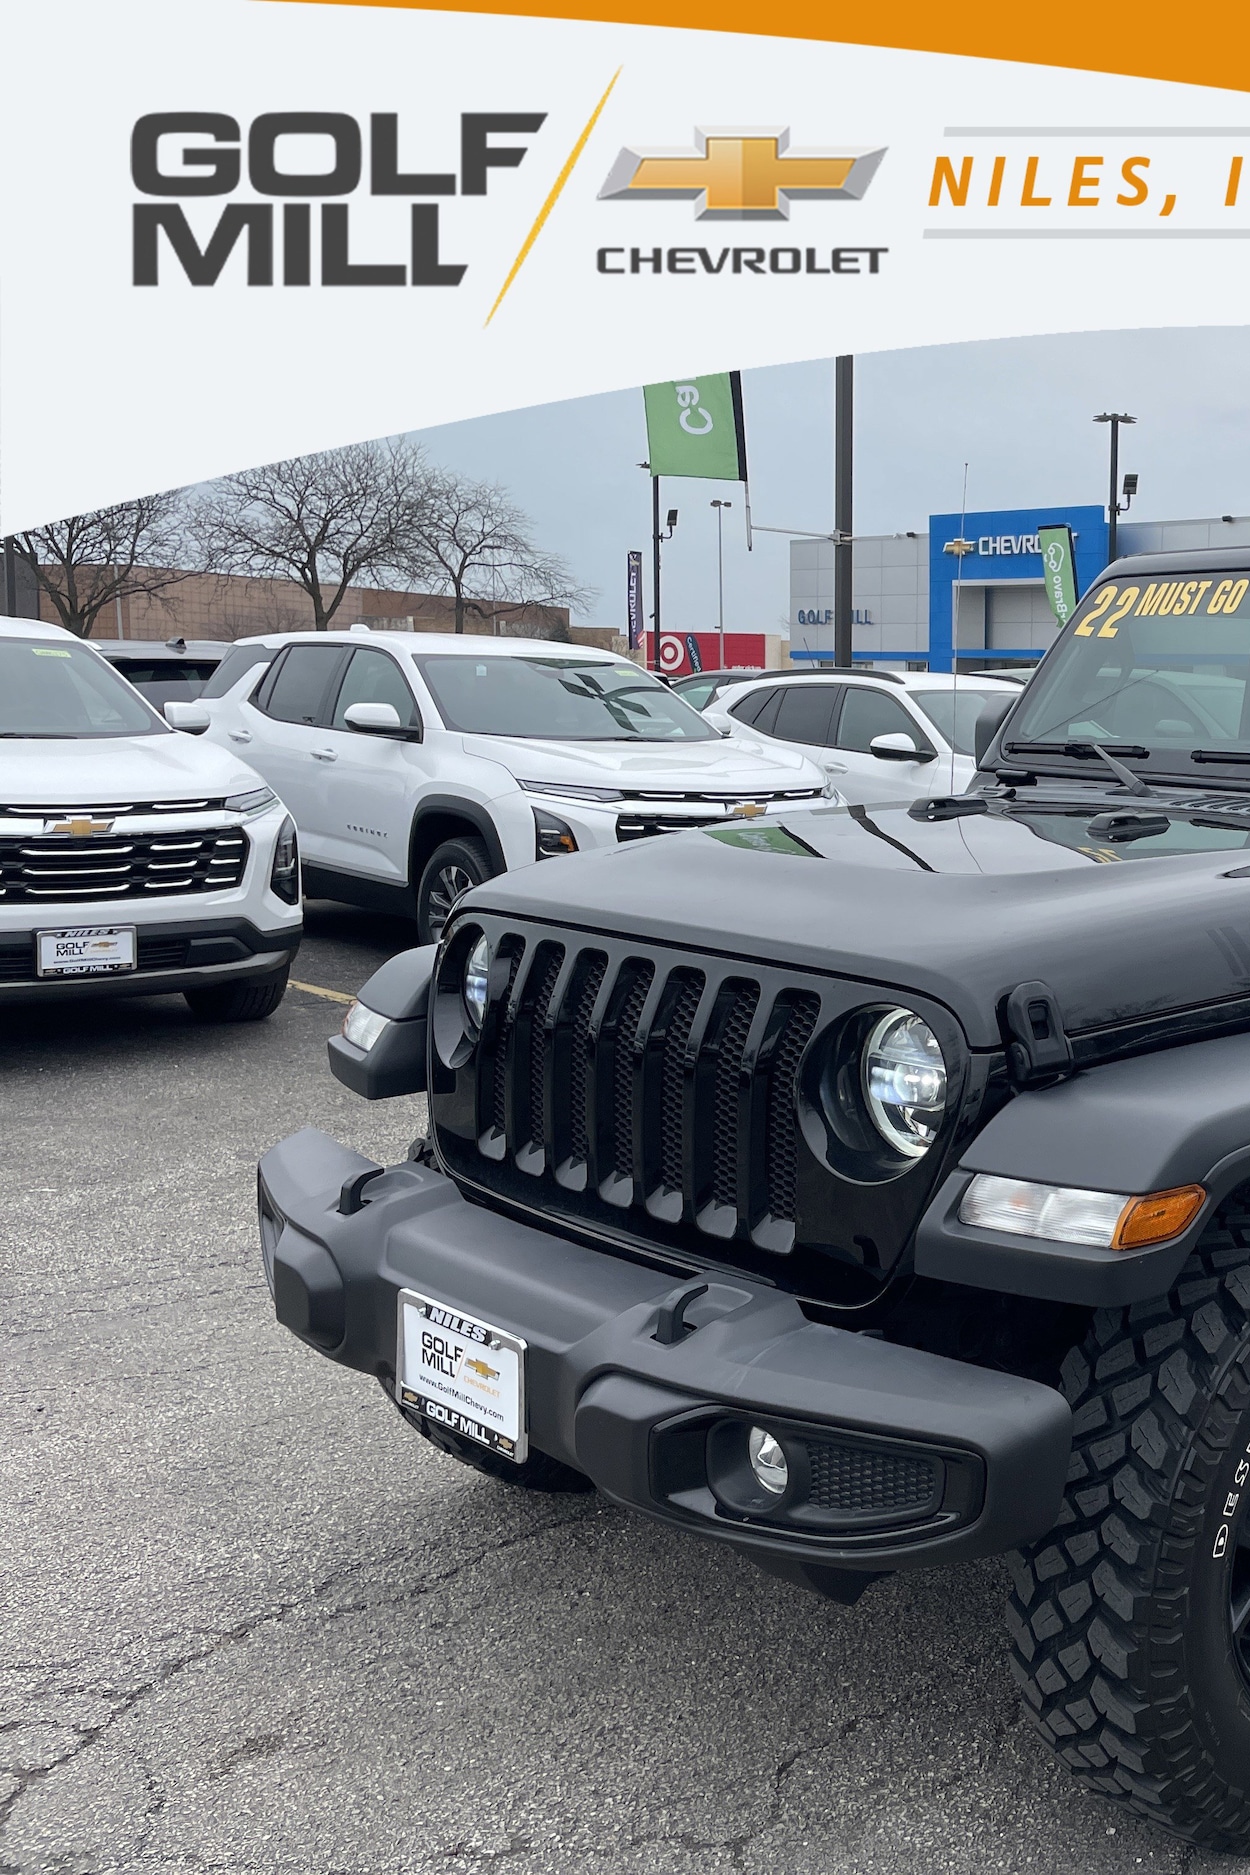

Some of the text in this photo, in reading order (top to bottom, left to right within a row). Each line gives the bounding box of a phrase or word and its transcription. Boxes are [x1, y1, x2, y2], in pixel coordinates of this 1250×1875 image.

[1074, 585, 1140, 638] 22
[1134, 578, 1249, 617] MUST GO
[798, 609, 873, 625] GOLF ILL
[687, 636, 702, 673] Certified
[56, 941, 90, 950] GOLF
[65, 929, 109, 938] NILES
[56, 949, 84, 957] MILL
[63, 964, 113, 975] GOLF MILL
[429, 1307, 487, 1342] NILES
[422, 1331, 463, 1362] GOLF
[422, 1347, 456, 1379] MILL
[419, 1374, 504, 1422] www.GolfMillChevy.com
[464, 1375, 500, 1399] CHEVROLET
[426, 1400, 490, 1445] GOLF MILL
